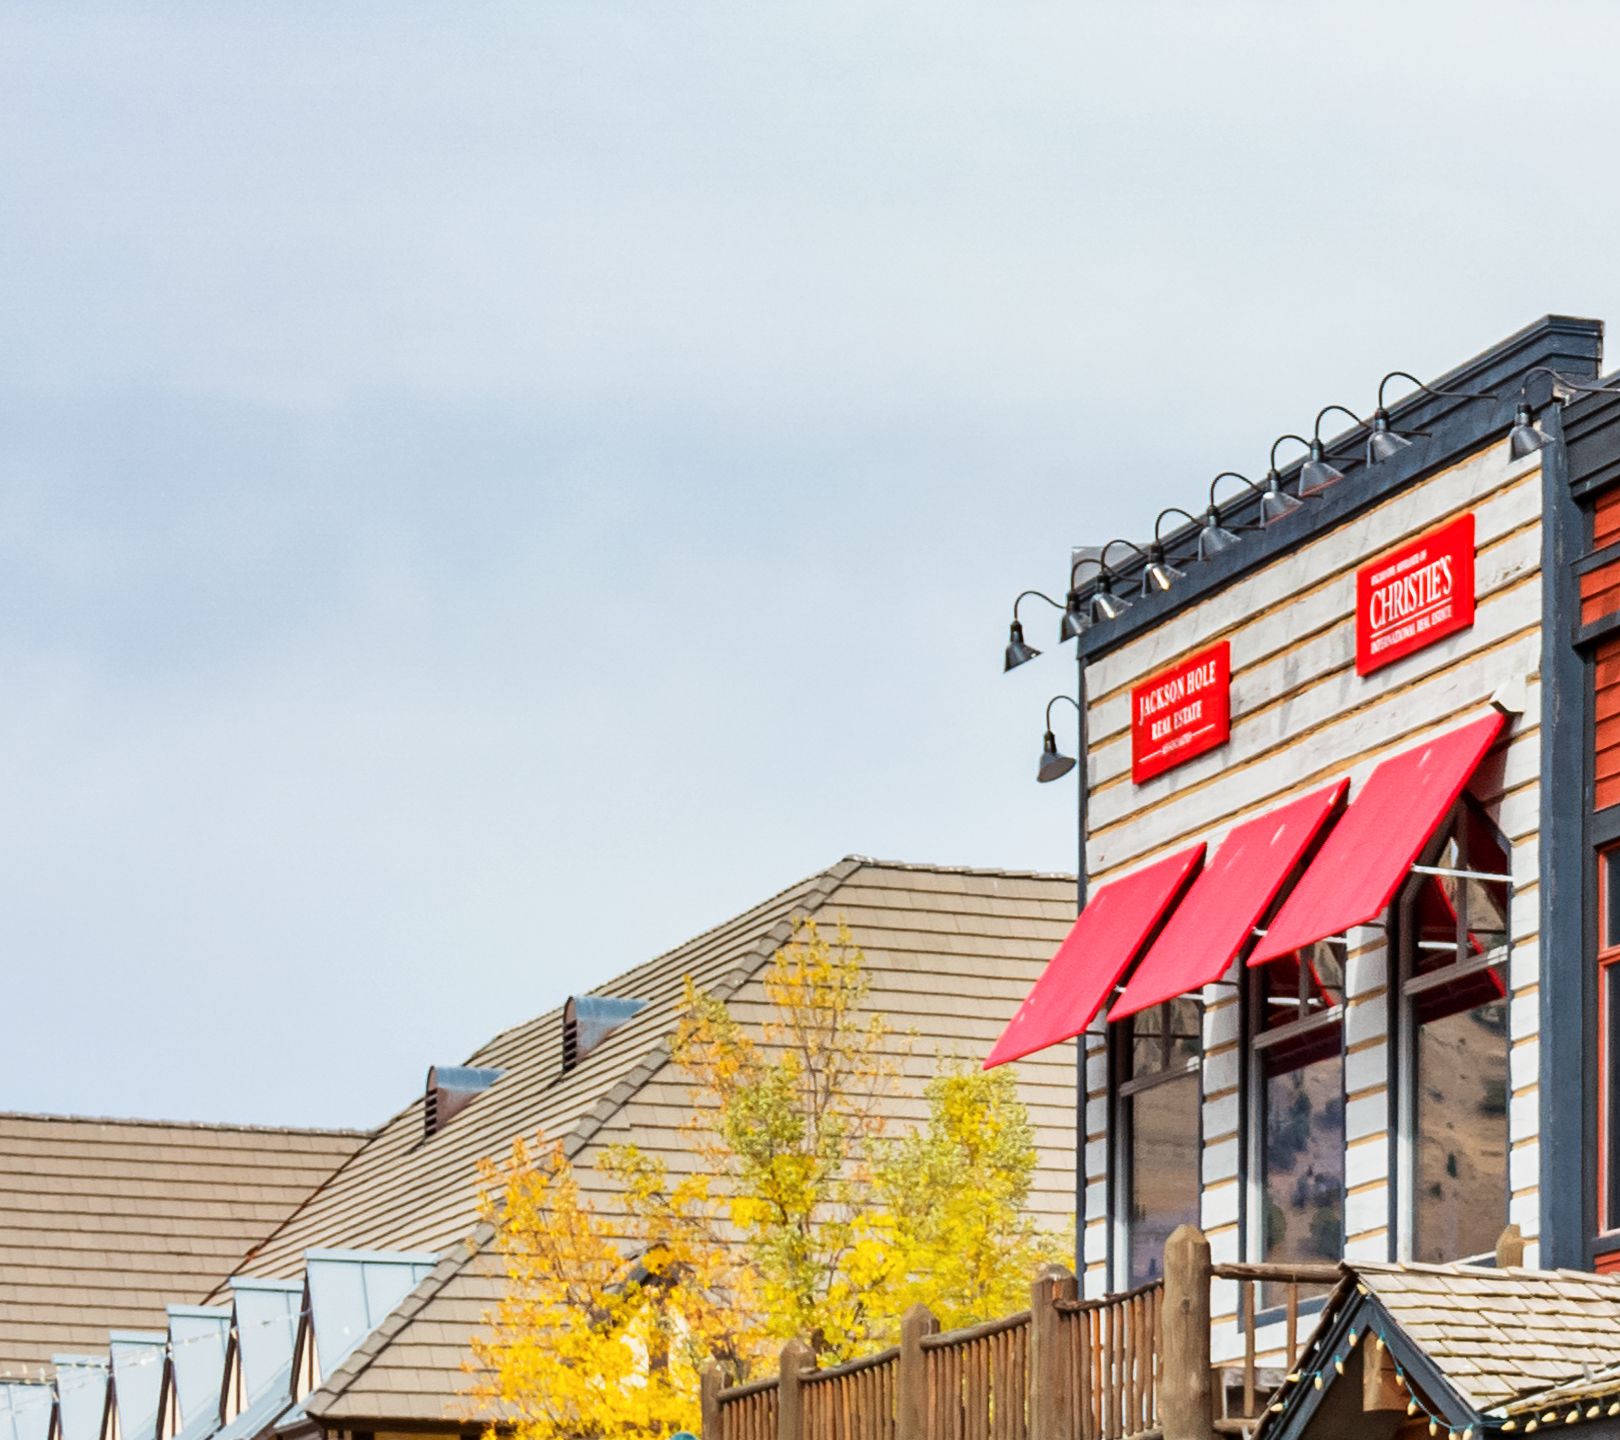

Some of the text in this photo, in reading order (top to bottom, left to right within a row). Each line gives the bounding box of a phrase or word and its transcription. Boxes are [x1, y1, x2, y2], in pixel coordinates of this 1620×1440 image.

[1369, 554, 1454, 630] CHRISTIE'S
[1138, 660, 1217, 727] JACKSON HOLE
